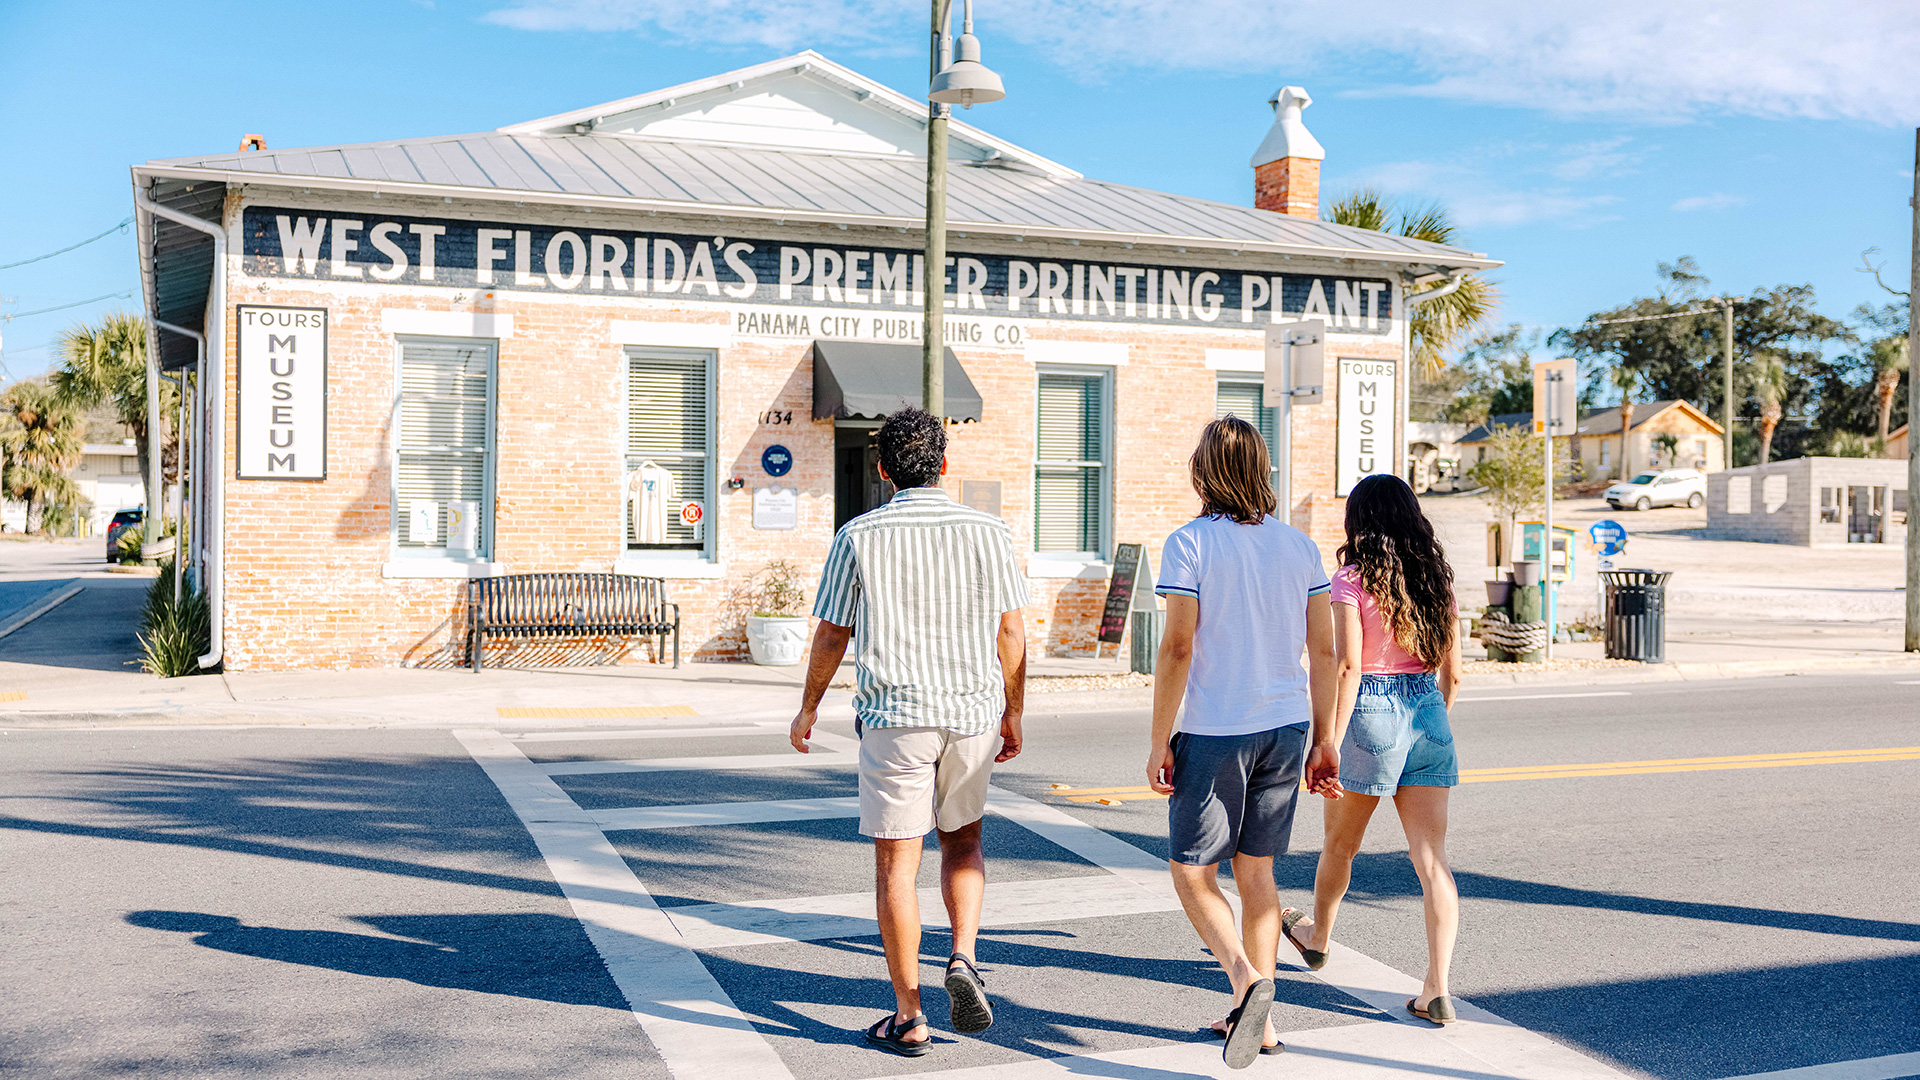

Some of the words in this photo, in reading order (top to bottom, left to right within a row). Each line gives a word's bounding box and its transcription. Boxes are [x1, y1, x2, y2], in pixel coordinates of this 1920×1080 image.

[276, 215, 446, 281] WEST
[477, 228, 758, 298] FLORIDA'S
[1008, 261, 1224, 322] PRINTING
[1241, 275, 1386, 329] PLANT
[245, 311, 321, 328] TOURS
[738, 312, 810, 335] PANAMA
[820, 316, 860, 337] CITY
[994, 325, 1023, 344] CO.
[1343, 363, 1393, 376] TOURS
[268, 334, 296, 472] MUSEUM
[758, 410, 792, 425] 1134
[1357, 381, 1377, 483] MUSEU
